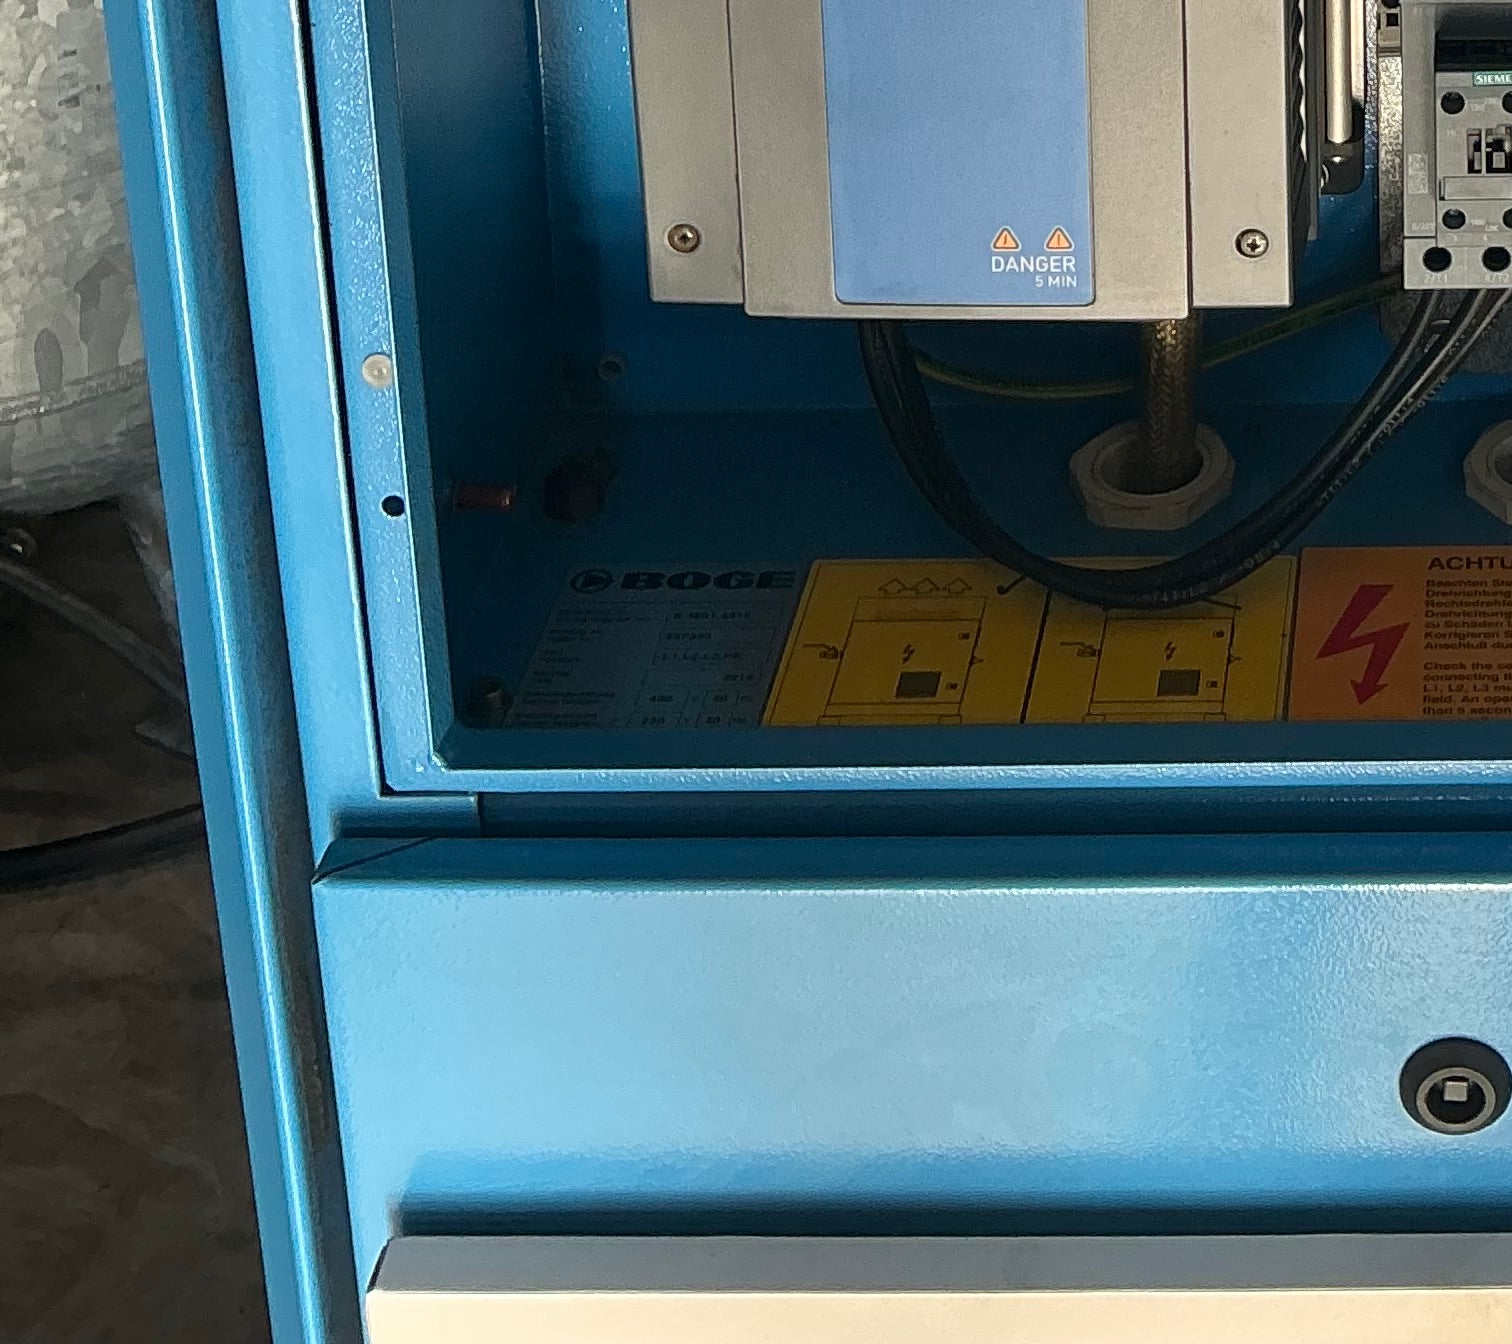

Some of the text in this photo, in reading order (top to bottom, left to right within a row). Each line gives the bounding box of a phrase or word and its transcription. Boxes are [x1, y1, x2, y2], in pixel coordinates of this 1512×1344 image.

[991, 256, 1076, 273] DANGER
[1035, 275, 1077, 288] 5 MIN
[620, 570, 797, 590] BOGE
[1424, 662, 1466, 670] Check
[1474, 684, 1488, 692] L3
[1462, 695, 1479, 703] An
[1423, 706, 1453, 714] than
